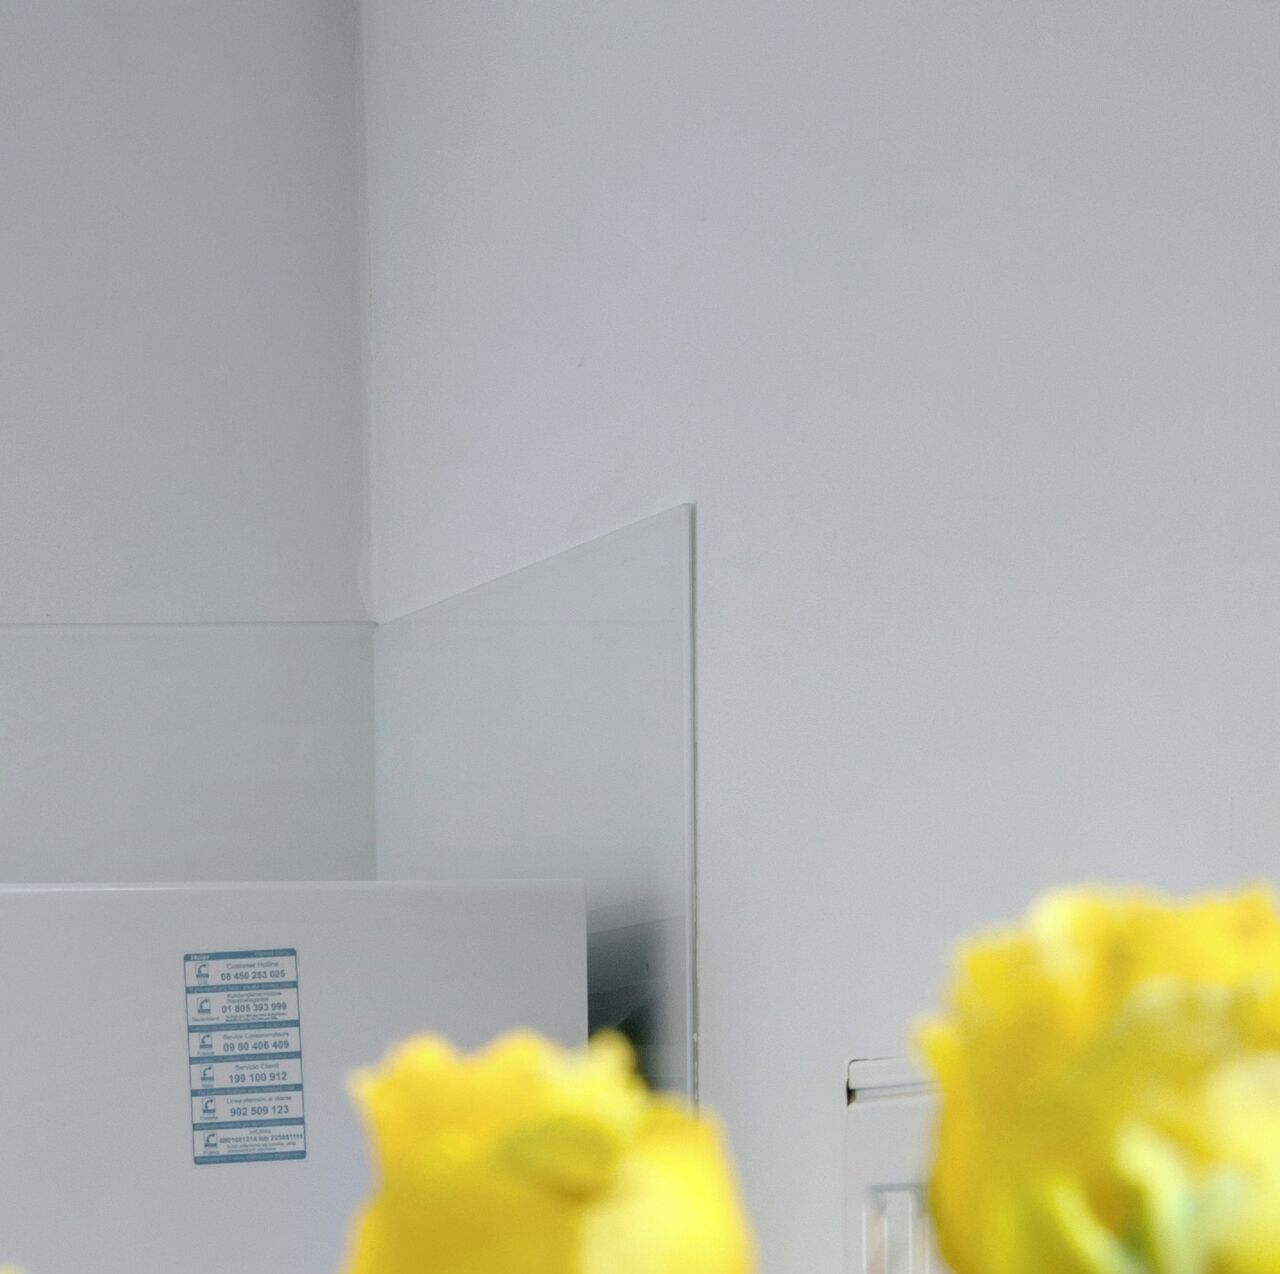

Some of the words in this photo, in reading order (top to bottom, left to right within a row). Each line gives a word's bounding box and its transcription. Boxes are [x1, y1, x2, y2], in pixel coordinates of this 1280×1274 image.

[220, 972, 231, 981] 08
[221, 1004, 232, 1014] 01
[234, 1003, 251, 1013] 805
[229, 1073, 246, 1083] 199
[249, 1072, 267, 1082] 100
[269, 1071, 287, 1081] 912
[230, 1106, 248, 1117] 902
[251, 1105, 269, 1116] 509
[271, 1104, 289, 1114] 123
